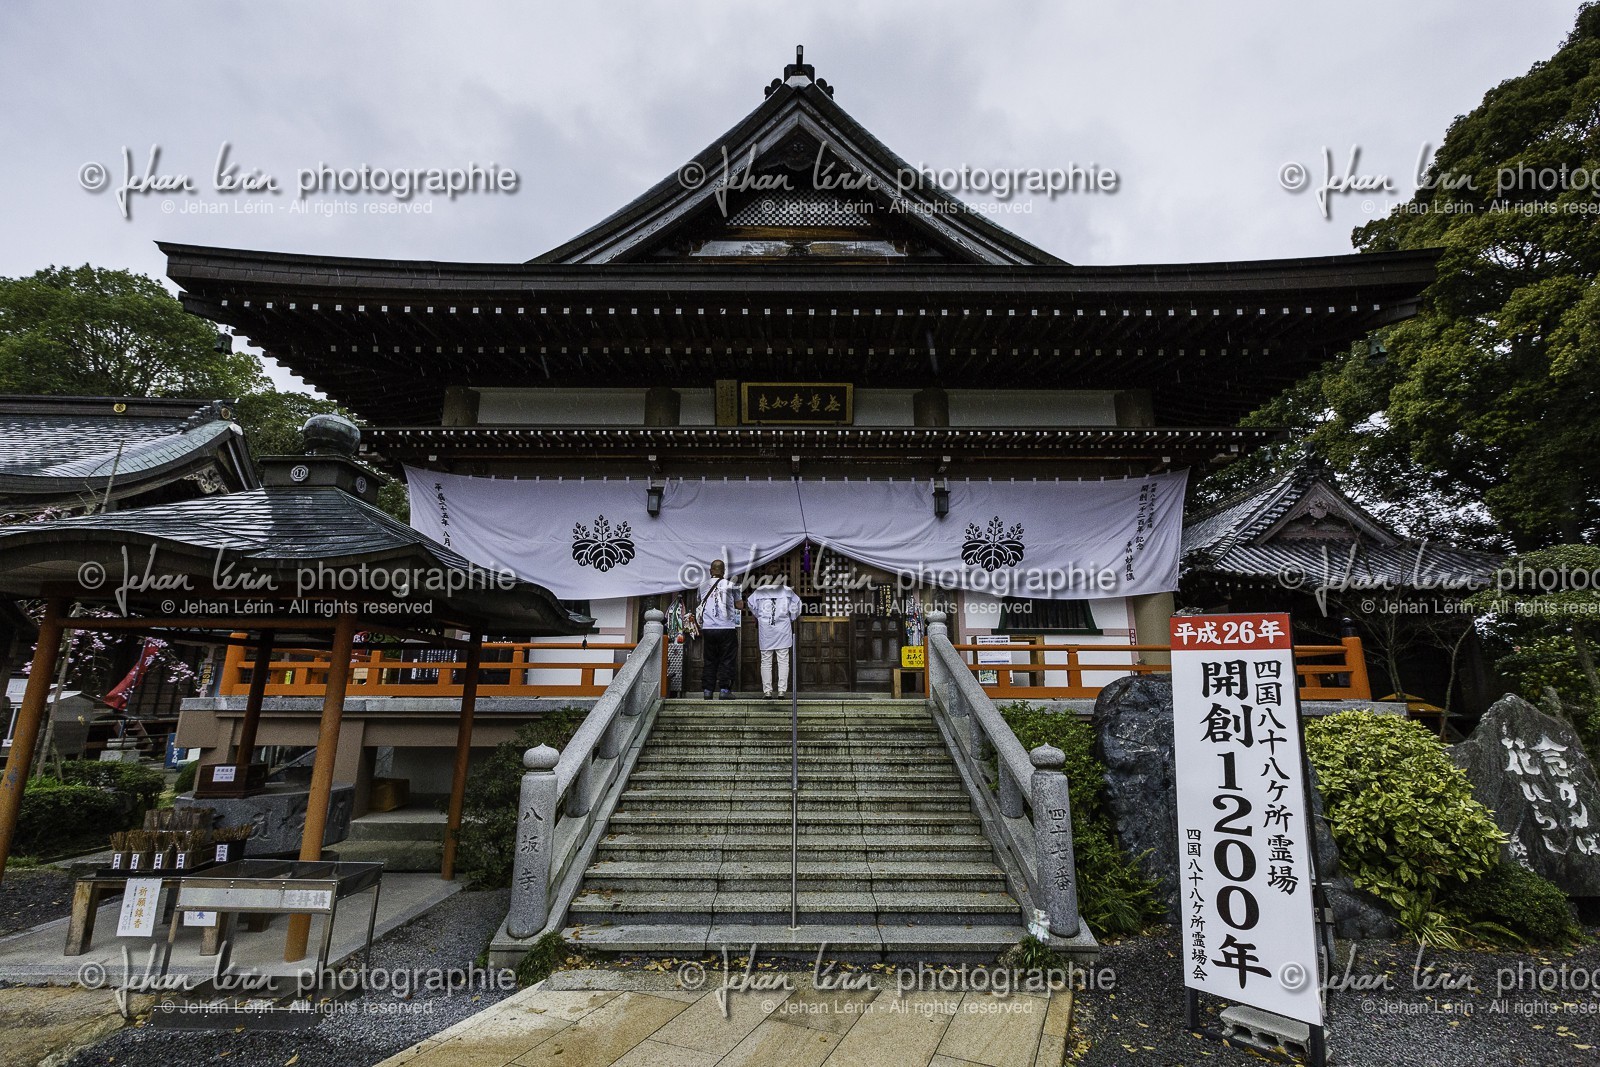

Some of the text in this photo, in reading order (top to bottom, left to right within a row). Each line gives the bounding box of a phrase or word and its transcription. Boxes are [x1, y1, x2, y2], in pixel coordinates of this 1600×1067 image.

[1173, 620, 1286, 645] 平成26年
[518, 806, 544, 891] 八坂寺
[1048, 807, 1073, 892] 四十七番
[1199, 659, 1273, 990] 開創1200年
